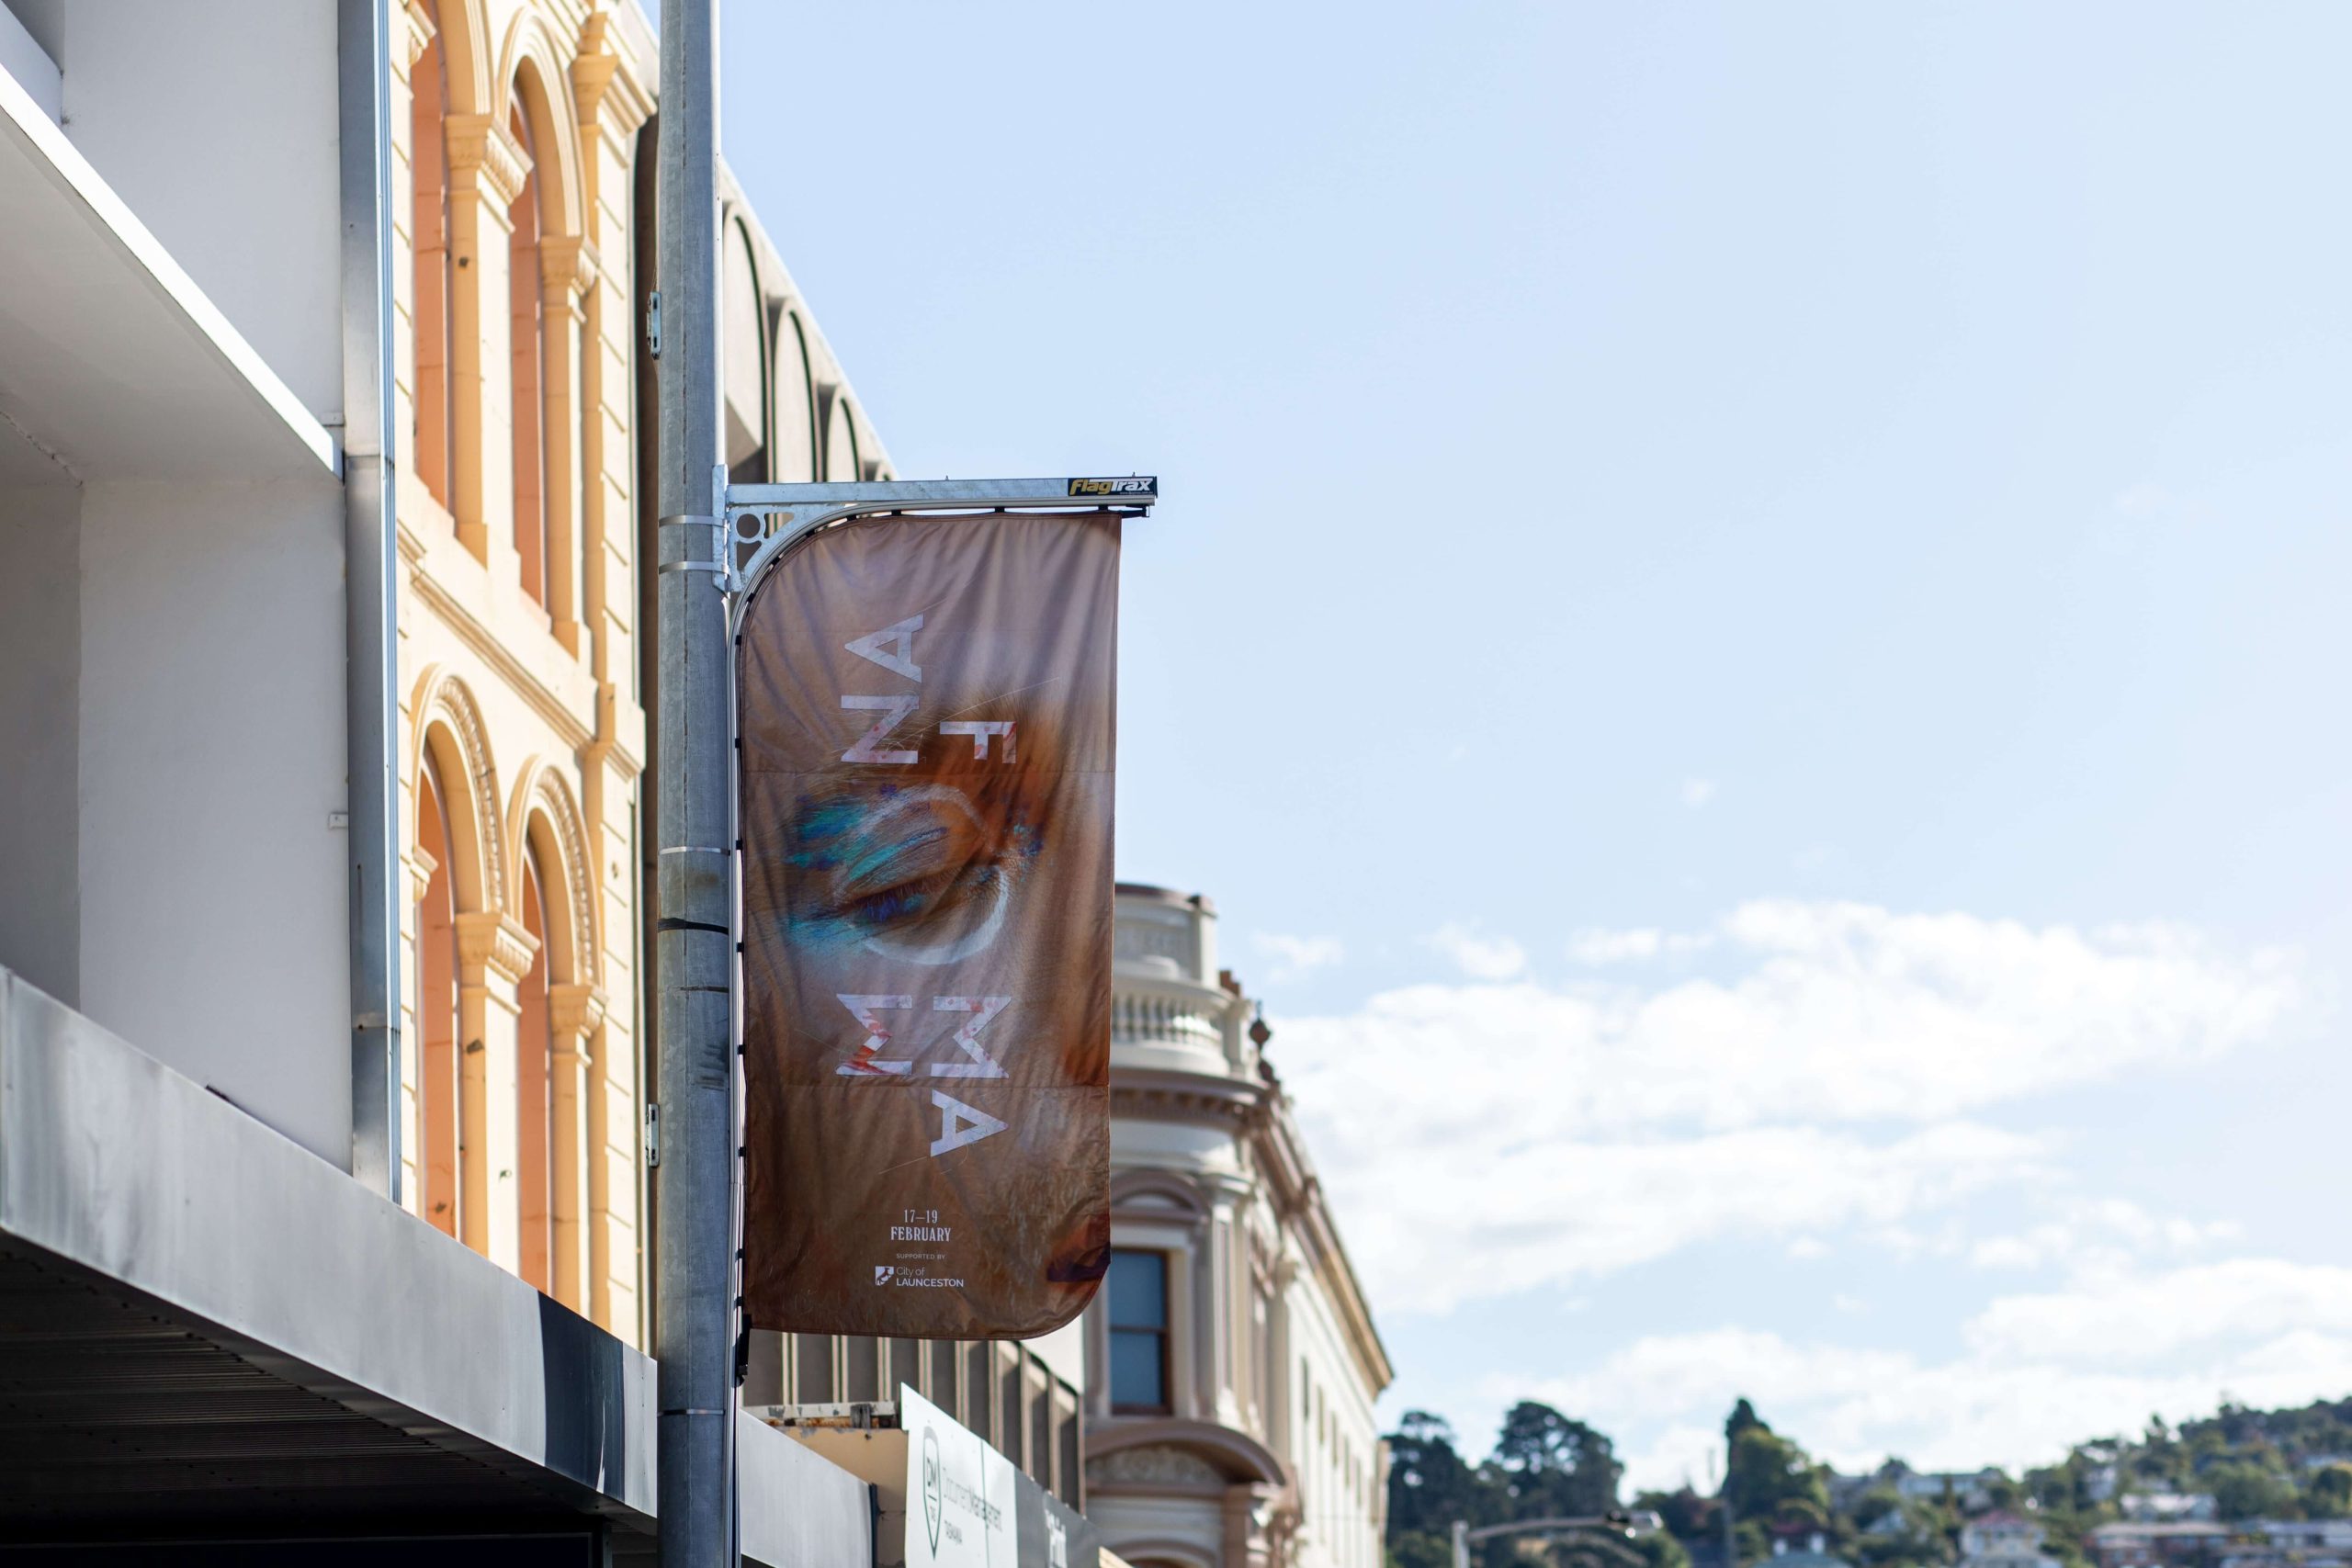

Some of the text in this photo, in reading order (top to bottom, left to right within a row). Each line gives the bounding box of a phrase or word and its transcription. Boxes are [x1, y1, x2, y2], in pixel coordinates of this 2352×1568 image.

[890, 1226, 952, 1242] FEBRUARY
[896, 1267, 925, 1278] City of
[896, 1278, 964, 1288] LAUNCESTON
